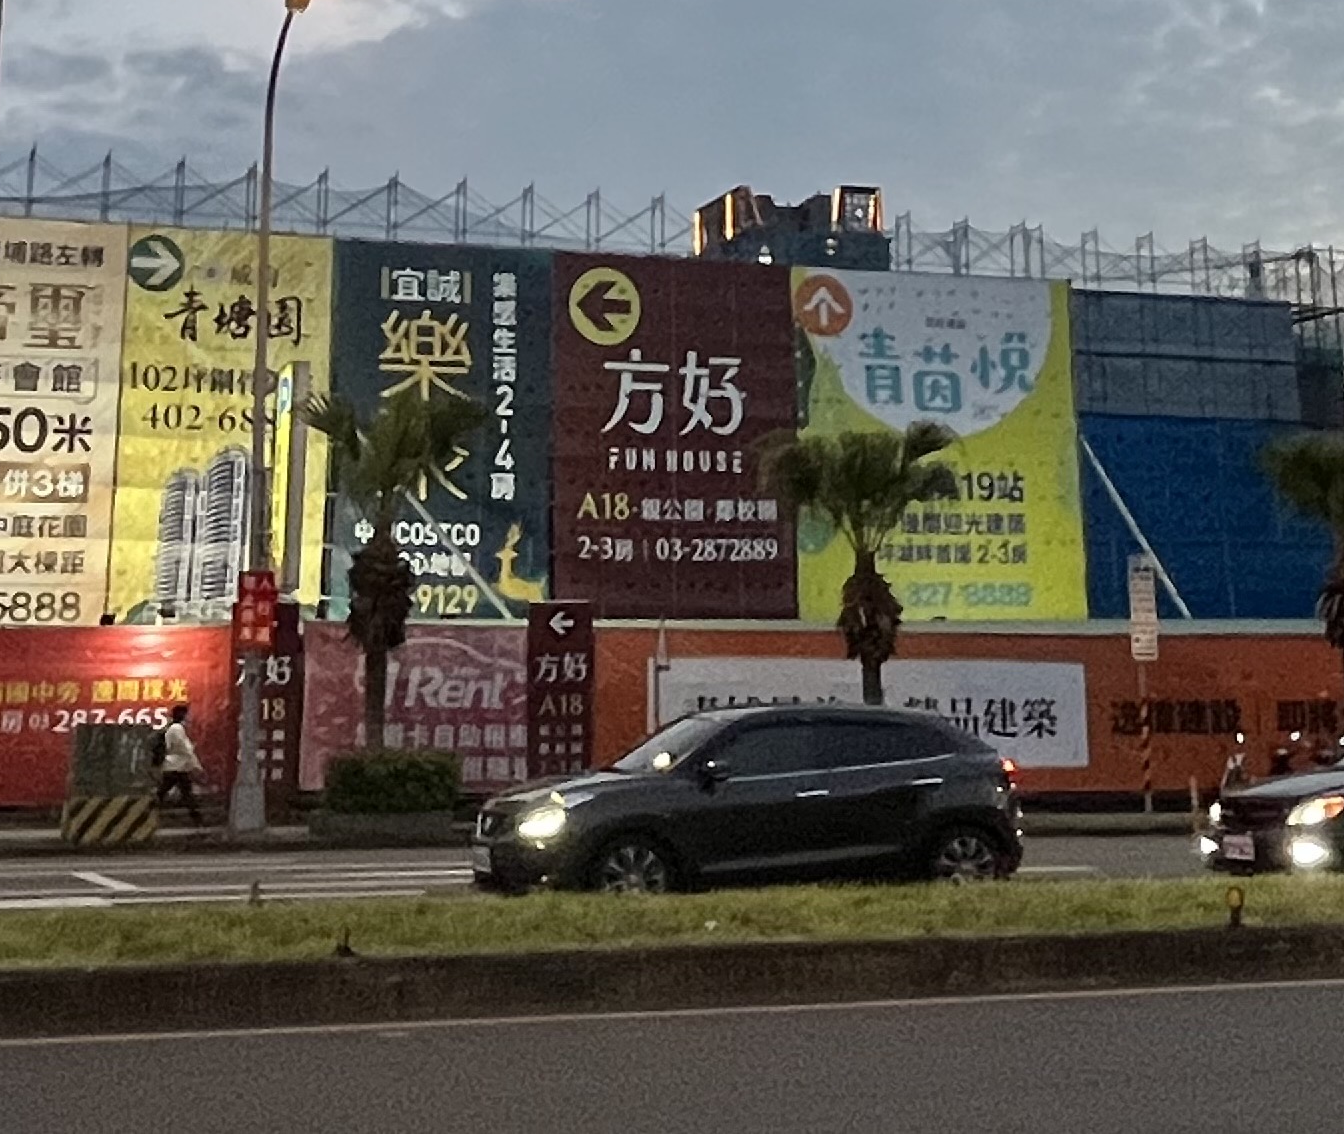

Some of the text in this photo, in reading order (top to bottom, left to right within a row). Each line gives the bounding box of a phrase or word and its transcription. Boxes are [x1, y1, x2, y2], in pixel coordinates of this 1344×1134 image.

[601, 349, 747, 436] 方好
[608, 447, 743, 474] FUN HOUSE
[960, 470, 1024, 503] 19站
[535, 652, 588, 682] 方好
[538, 694, 584, 717] A18
